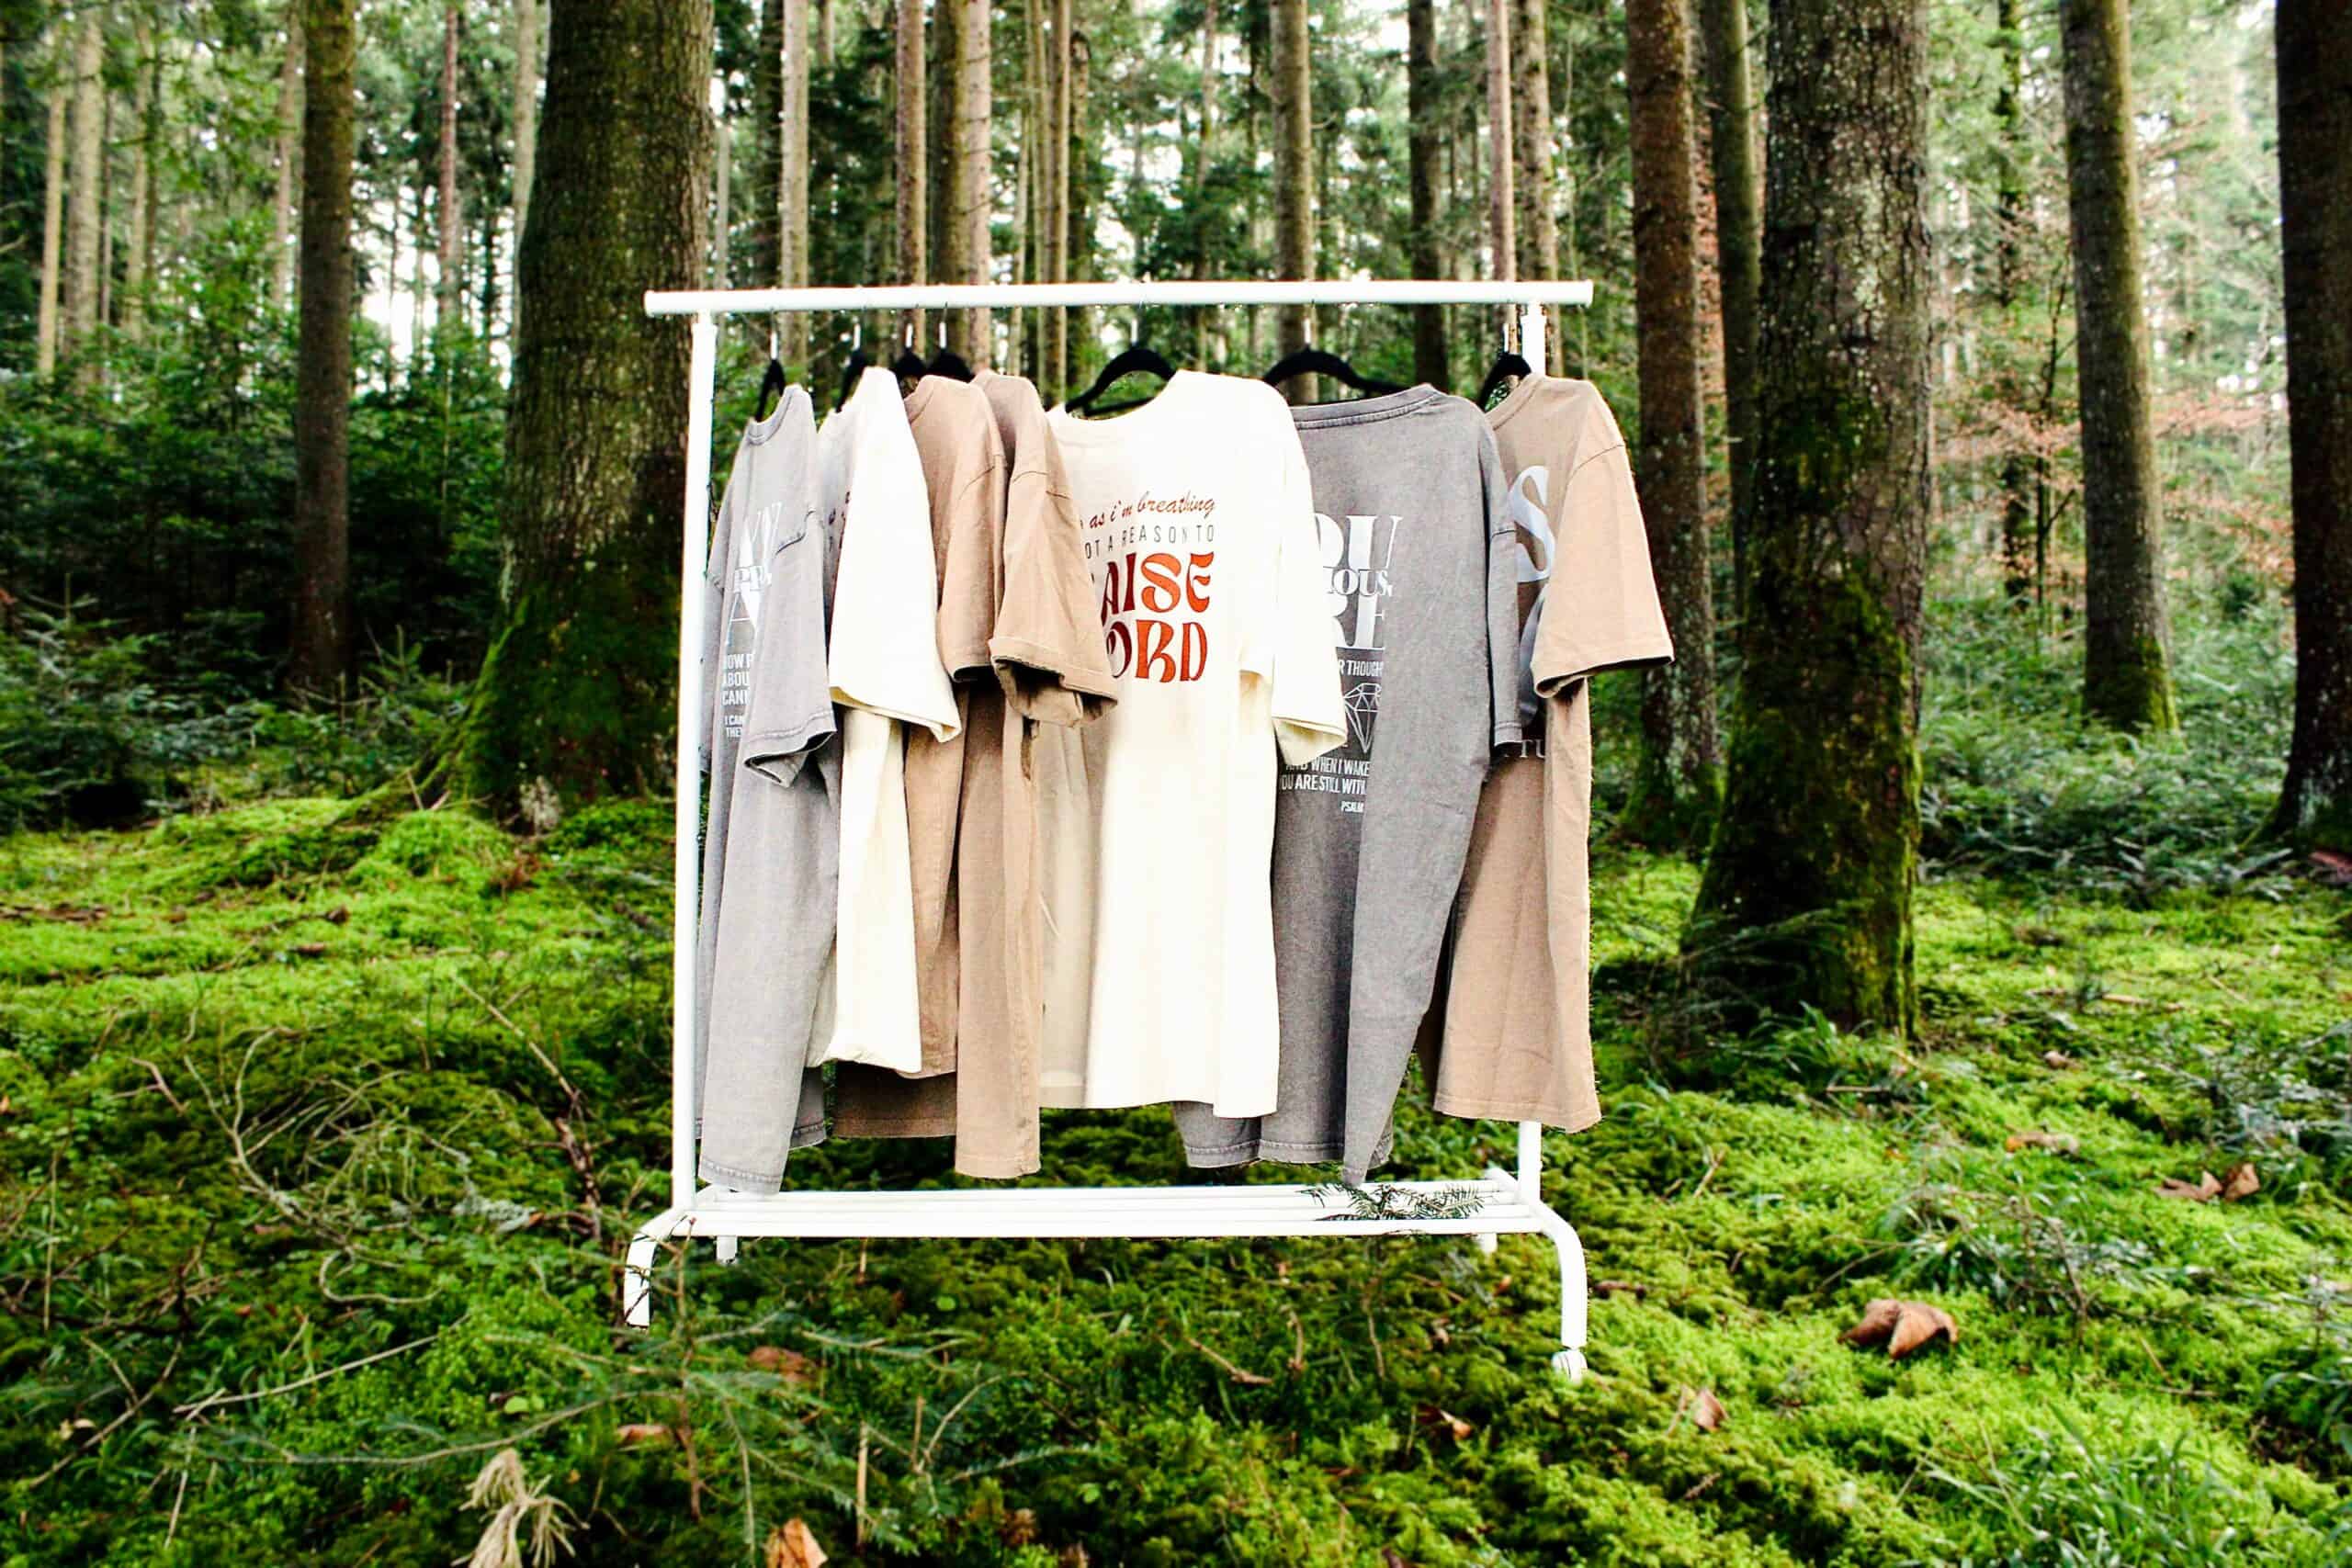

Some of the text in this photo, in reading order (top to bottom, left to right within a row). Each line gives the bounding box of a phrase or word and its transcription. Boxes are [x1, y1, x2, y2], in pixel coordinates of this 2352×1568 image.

[1090, 512, 1105, 529] as
[1110, 500, 1133, 522] i'm
[1136, 489, 1216, 520] breathing
[1121, 525, 1188, 547] REASON
[1195, 524, 1215, 543] TO
[1091, 551, 1215, 627] AISE
[1105, 619, 1208, 683] ORD
[1295, 774, 1318, 791] ARE
[1318, 776, 1340, 793] STILL
[1344, 761, 1370, 777] WAKE
